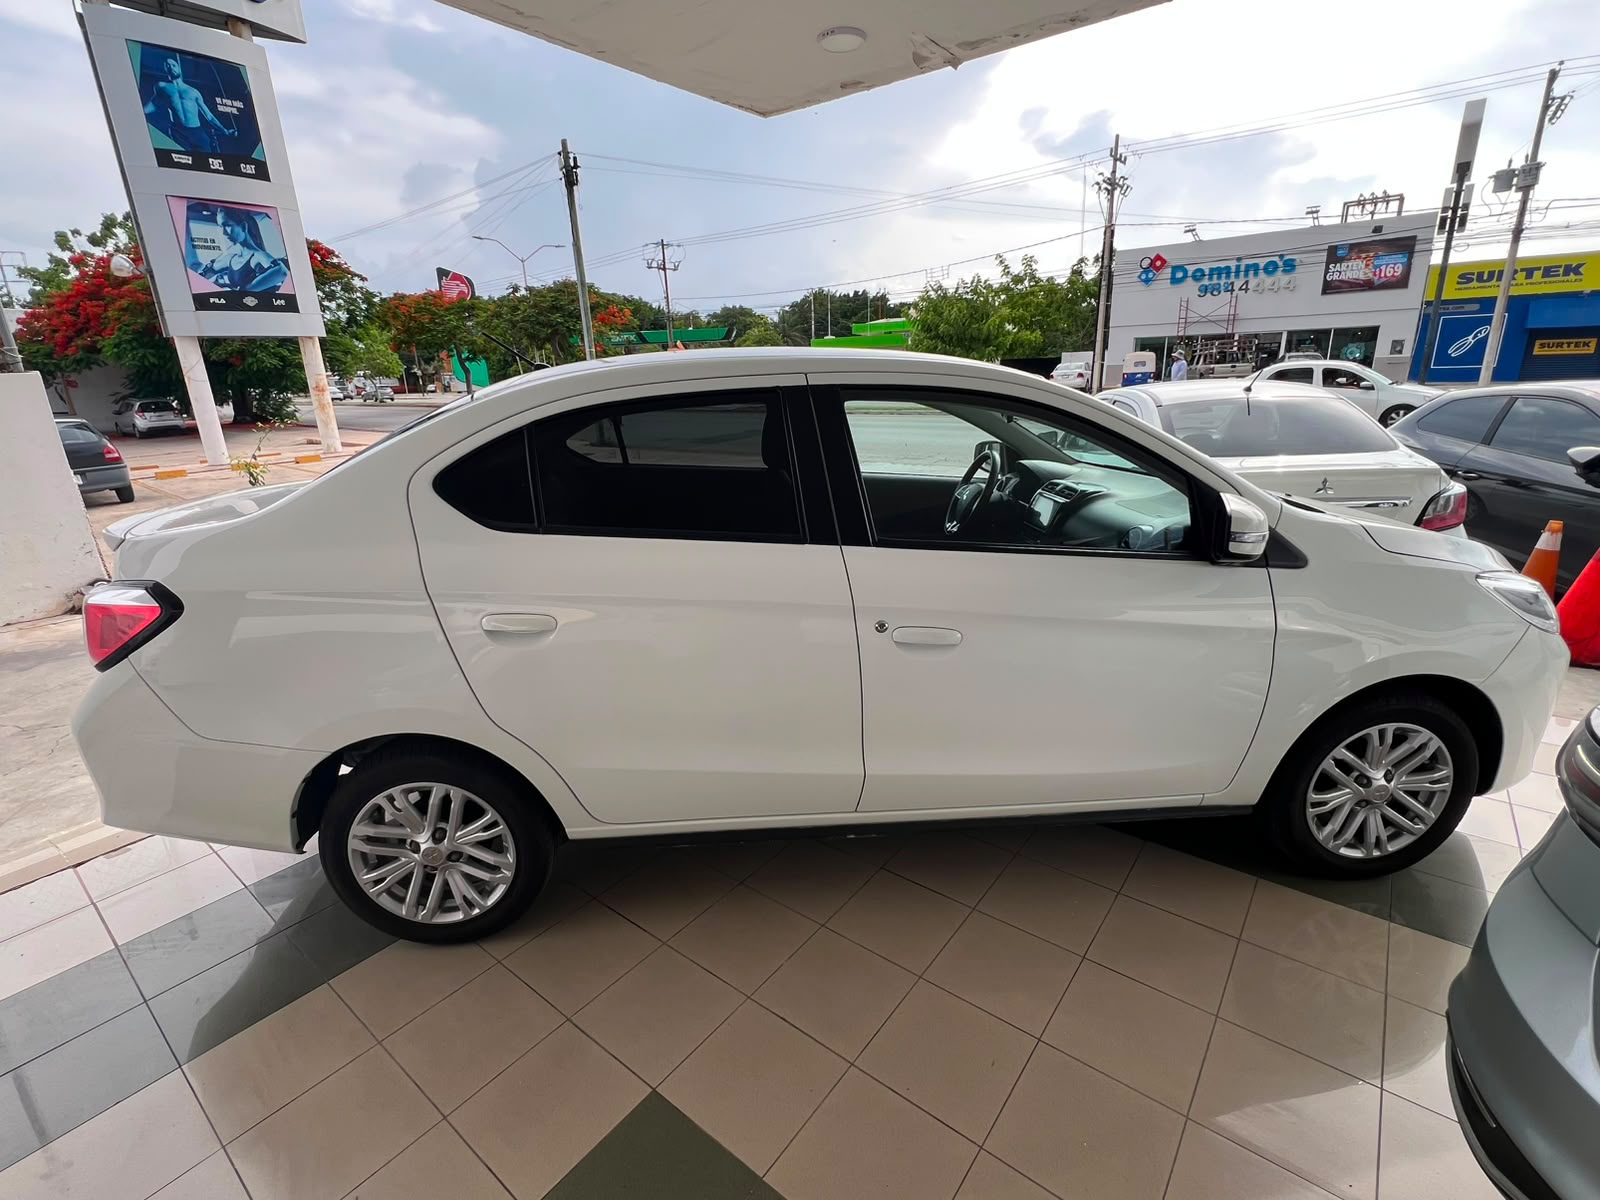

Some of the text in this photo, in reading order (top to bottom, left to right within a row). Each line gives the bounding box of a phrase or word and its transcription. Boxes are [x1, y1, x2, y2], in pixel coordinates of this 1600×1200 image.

[240, 163, 256, 174] CAT
[1170, 253, 1297, 285] Domino's
[1326, 269, 1368, 281] GRANDE
[1374, 263, 1403, 279] $169
[1456, 263, 1586, 285] SURTEK
[272, 298, 286, 306] Lee
[1538, 341, 1591, 349] SURTEK
